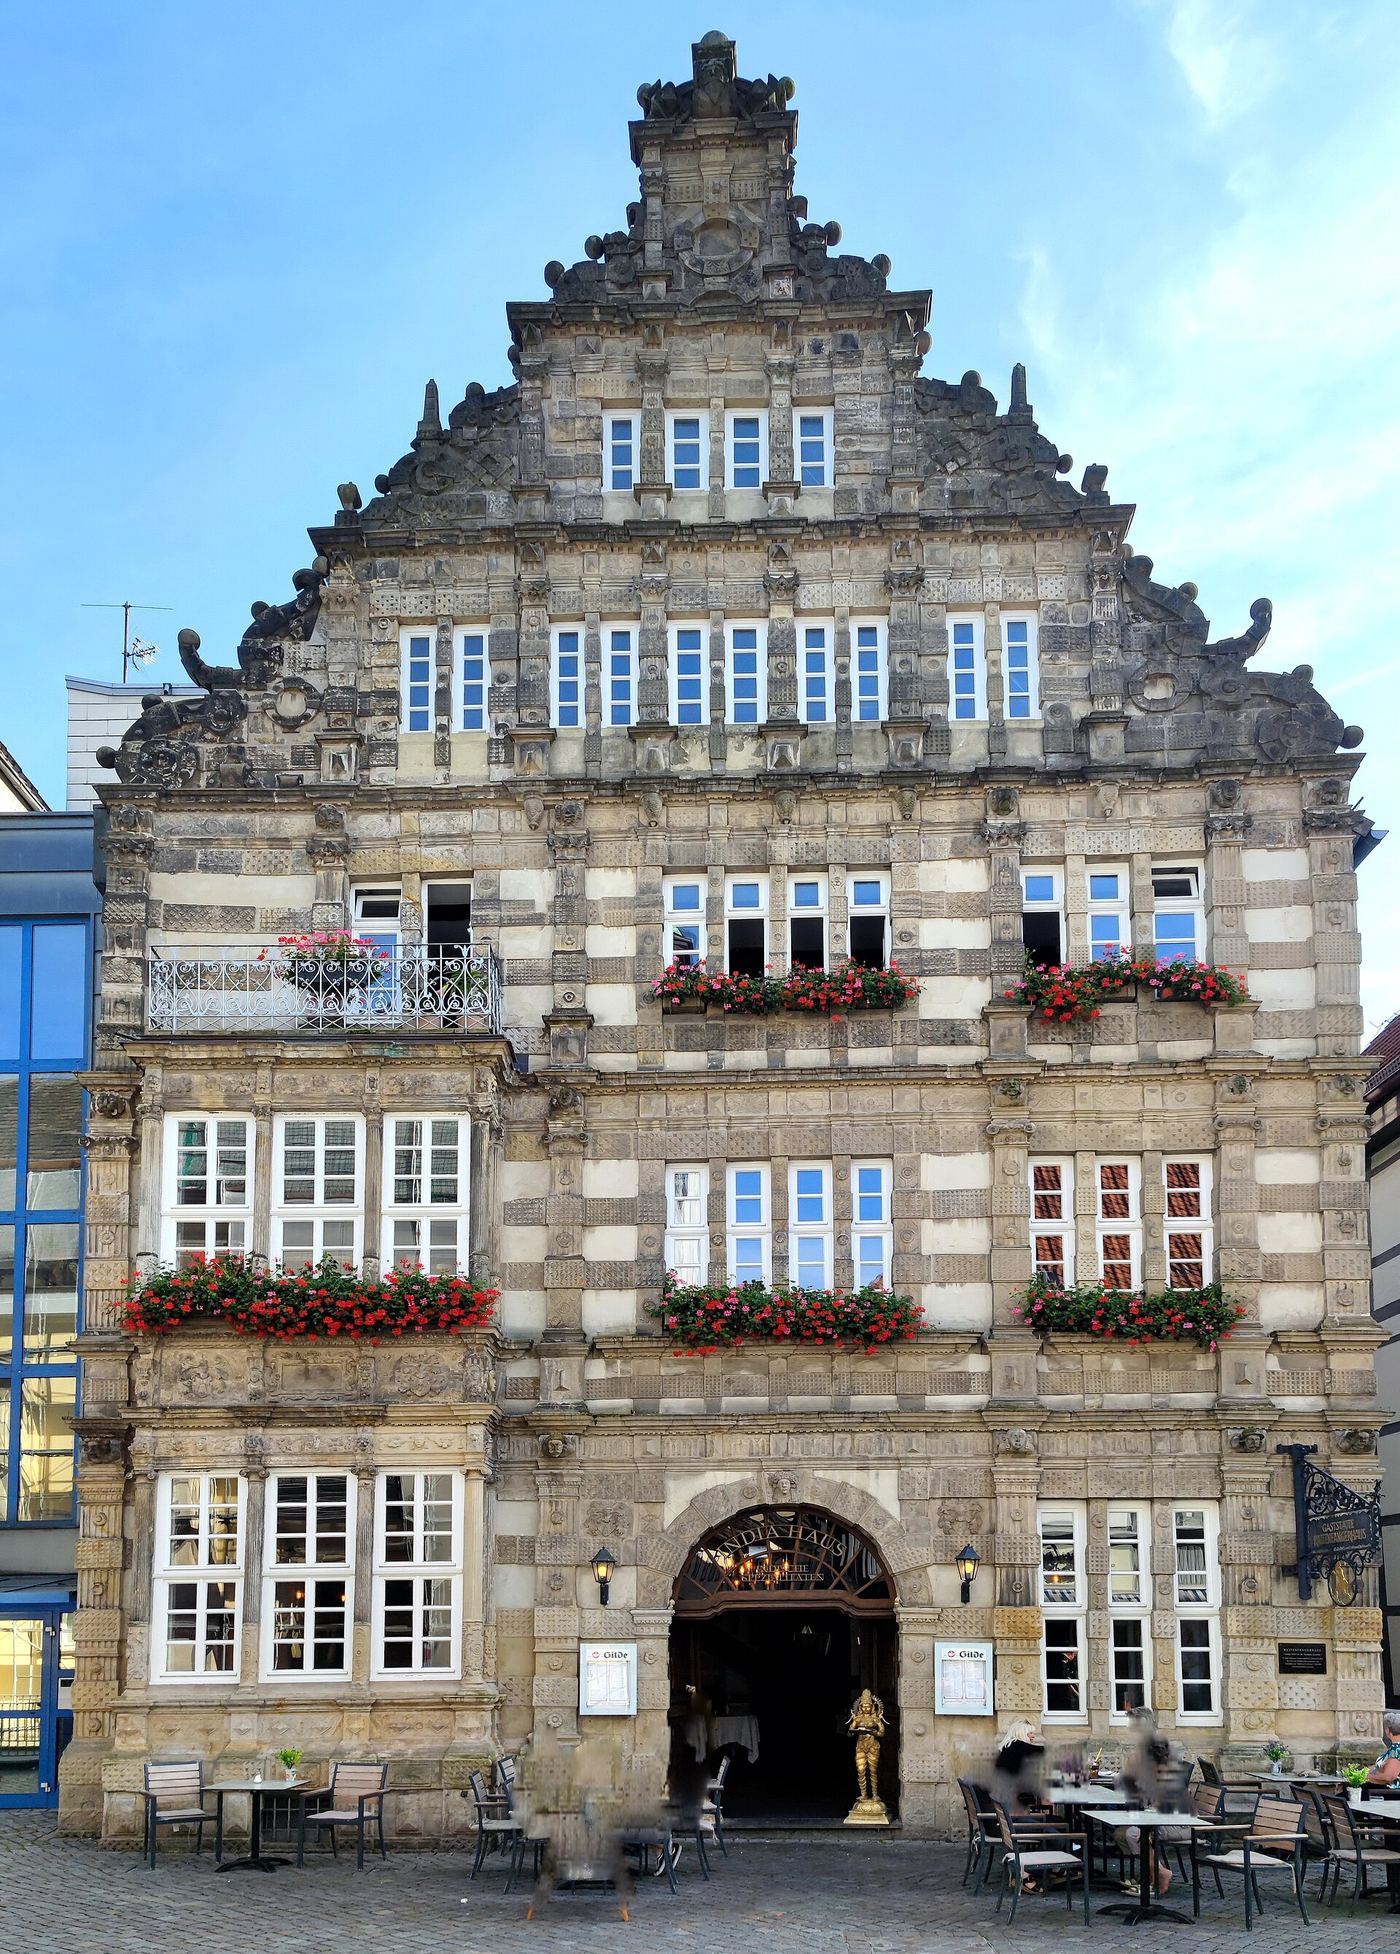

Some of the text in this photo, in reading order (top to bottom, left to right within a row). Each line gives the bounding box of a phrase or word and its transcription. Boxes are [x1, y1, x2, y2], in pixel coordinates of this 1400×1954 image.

[714, 1525, 847, 1557] INDIA HAUS
[603, 1651, 628, 1659] Gilde
[959, 1651, 984, 1659] Gilde
